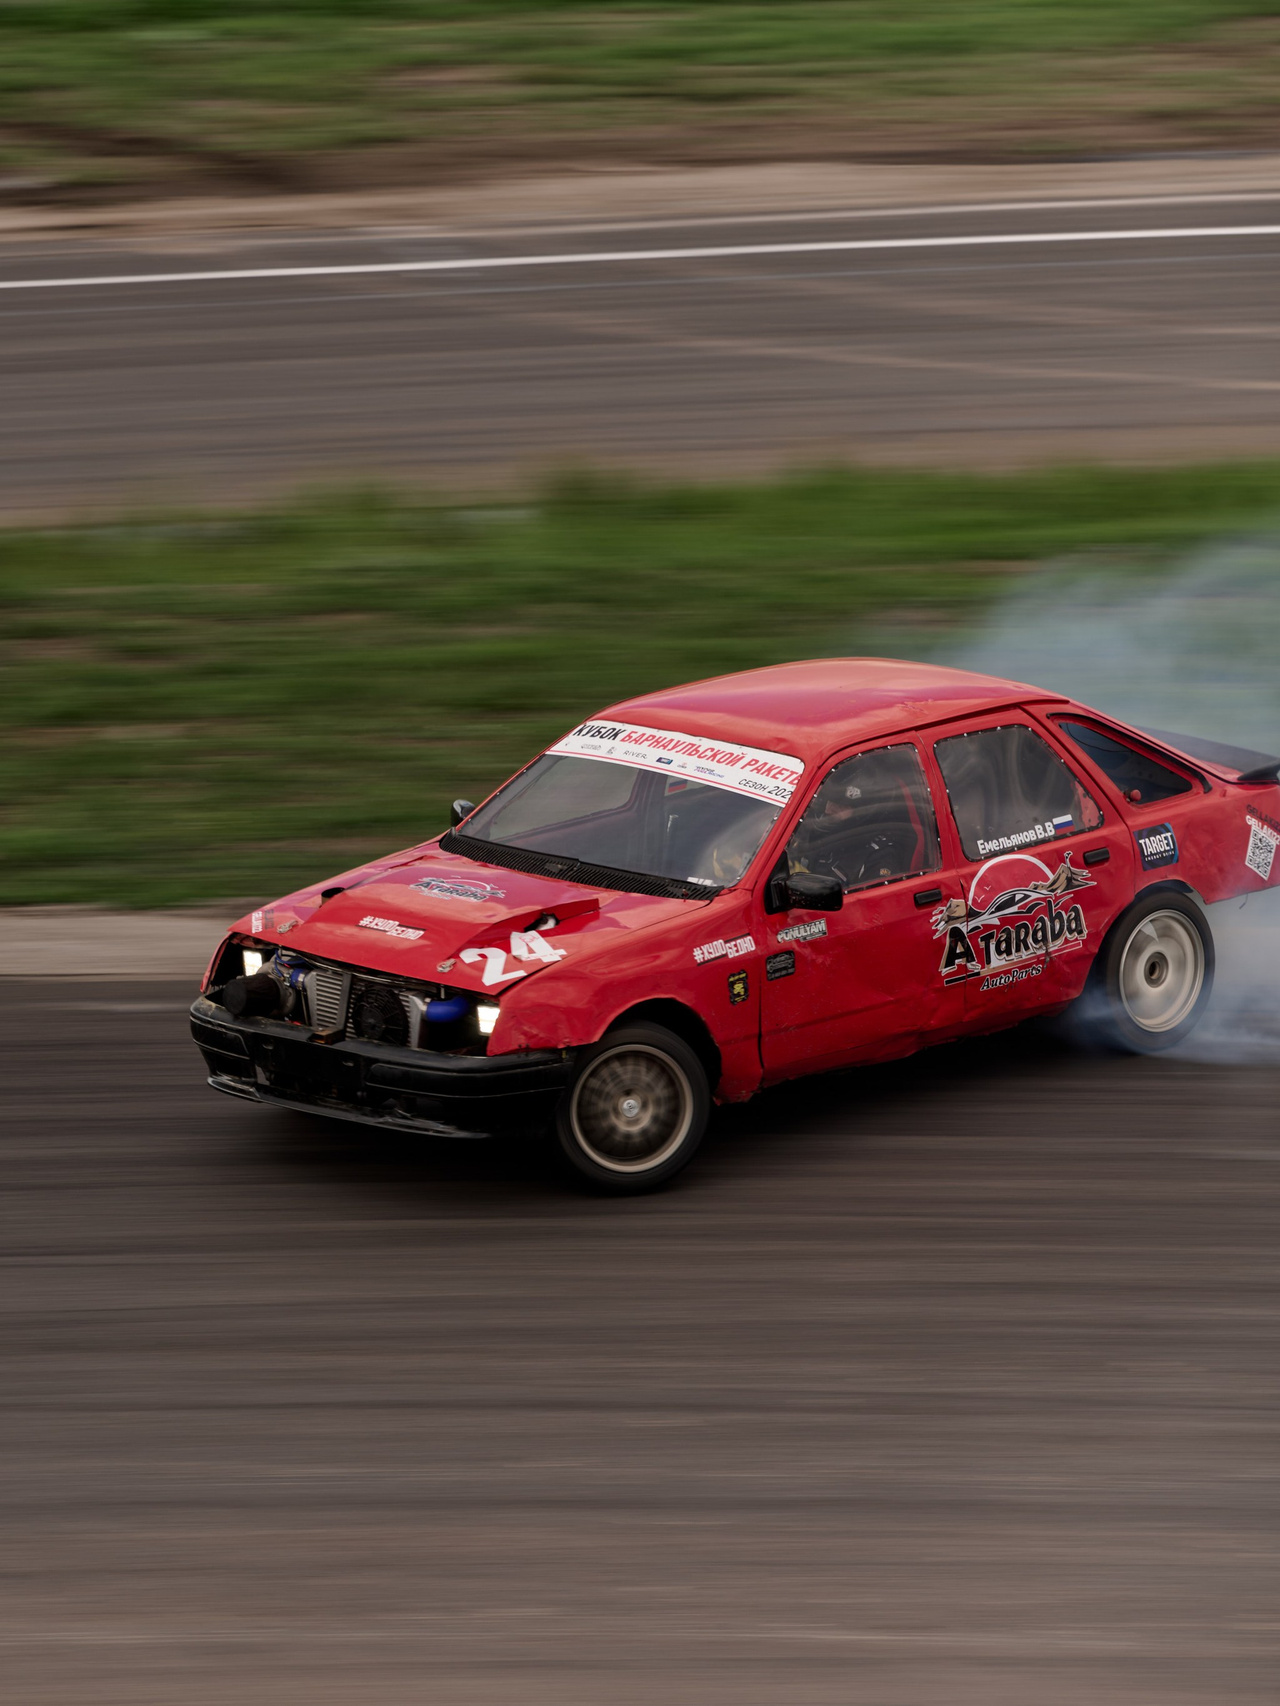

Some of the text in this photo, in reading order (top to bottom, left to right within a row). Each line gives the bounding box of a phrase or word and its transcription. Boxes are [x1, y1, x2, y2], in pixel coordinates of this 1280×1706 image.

[573, 724, 626, 741] КУБОК
[620, 730, 748, 767] БАРНАУЛЬСКОЙ
[623, 750, 648, 759] RIVER
[738, 778, 769, 792] СЕЗОН
[1139, 833, 1174, 856] TARGET
[459, 930, 567, 986] 24
[980, 964, 1043, 991] AutoParts
